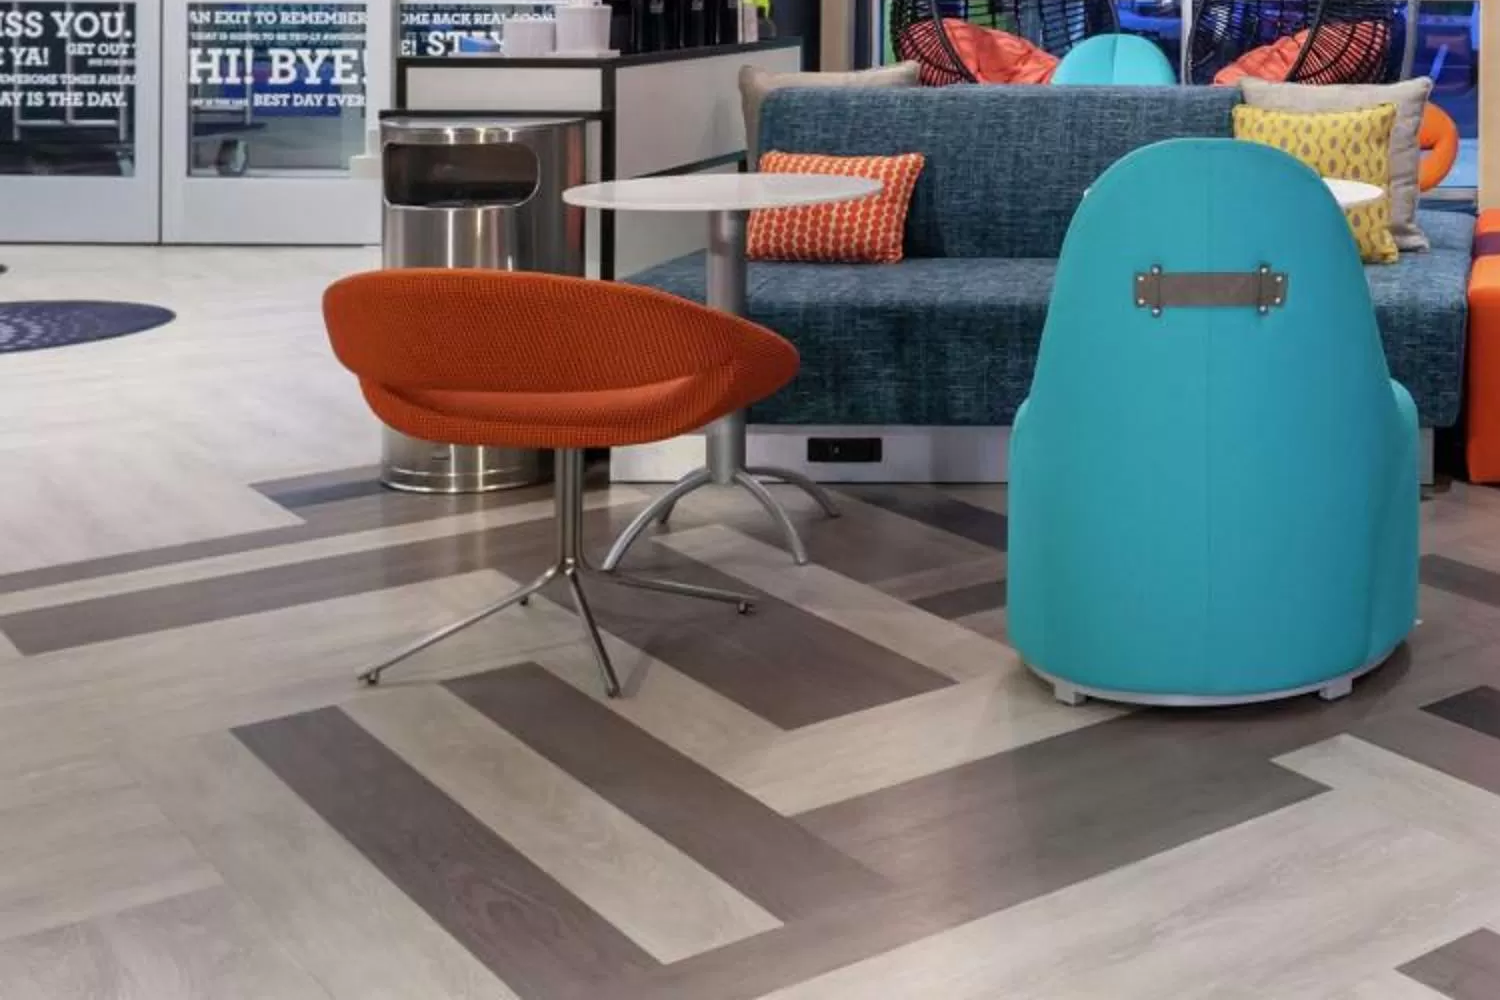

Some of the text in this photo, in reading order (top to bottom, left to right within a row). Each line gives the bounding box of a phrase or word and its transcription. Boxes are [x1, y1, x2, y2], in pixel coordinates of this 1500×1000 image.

[50, 11, 132, 38] YOU.
[215, 11, 250, 25] EXIT
[254, 11, 277, 25] TO
[432, 13, 472, 25] BACK
[66, 42, 129, 55] GET OUT
[9, 47, 49, 66] YA!
[190, 48, 254, 85] HI!
[26, 91, 44, 107] IS
[47, 91, 84, 107] THE
[253, 93, 290, 107] BEST
[293, 93, 324, 107] DAY
